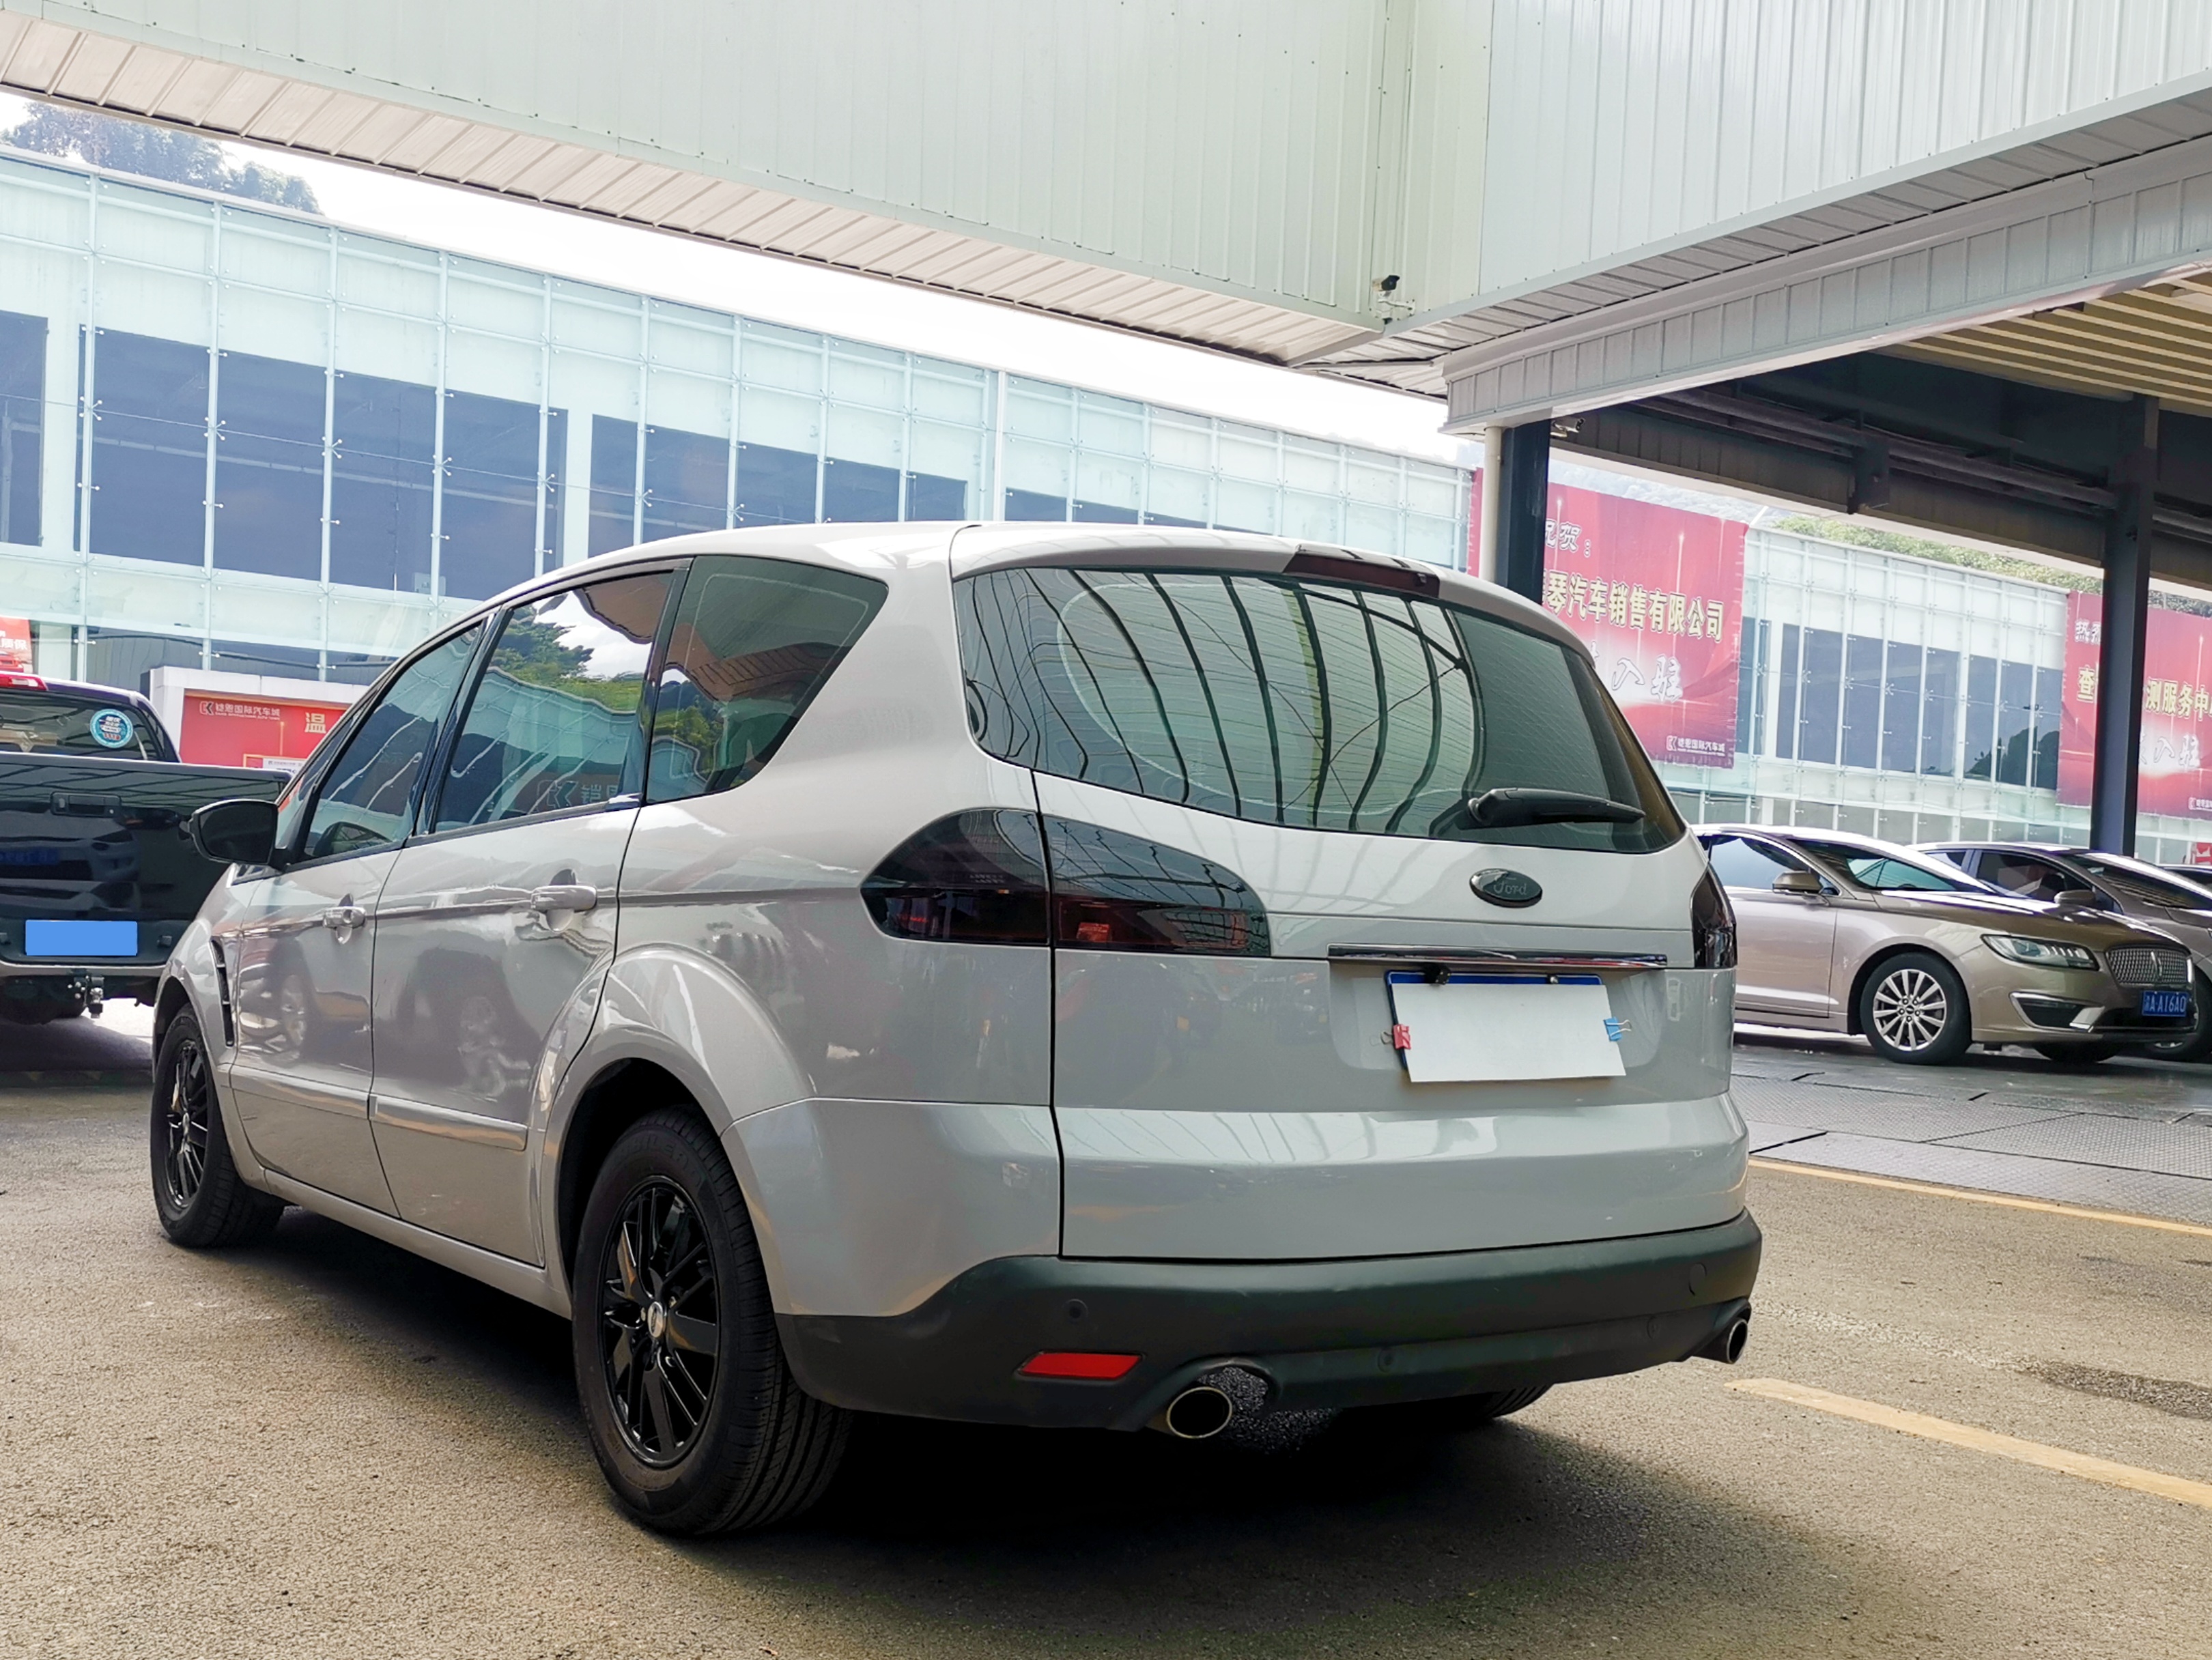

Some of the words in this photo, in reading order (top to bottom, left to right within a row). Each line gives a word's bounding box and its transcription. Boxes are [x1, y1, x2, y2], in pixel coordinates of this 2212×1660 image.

[1544, 569, 1725, 644] 琴汽车销售有限公司
[1590, 640, 1684, 703] 入驻
[2145, 676, 2212, 721] 测服务中
[304, 712, 326, 734] 温
[2141, 726, 2200, 771] 入驻
